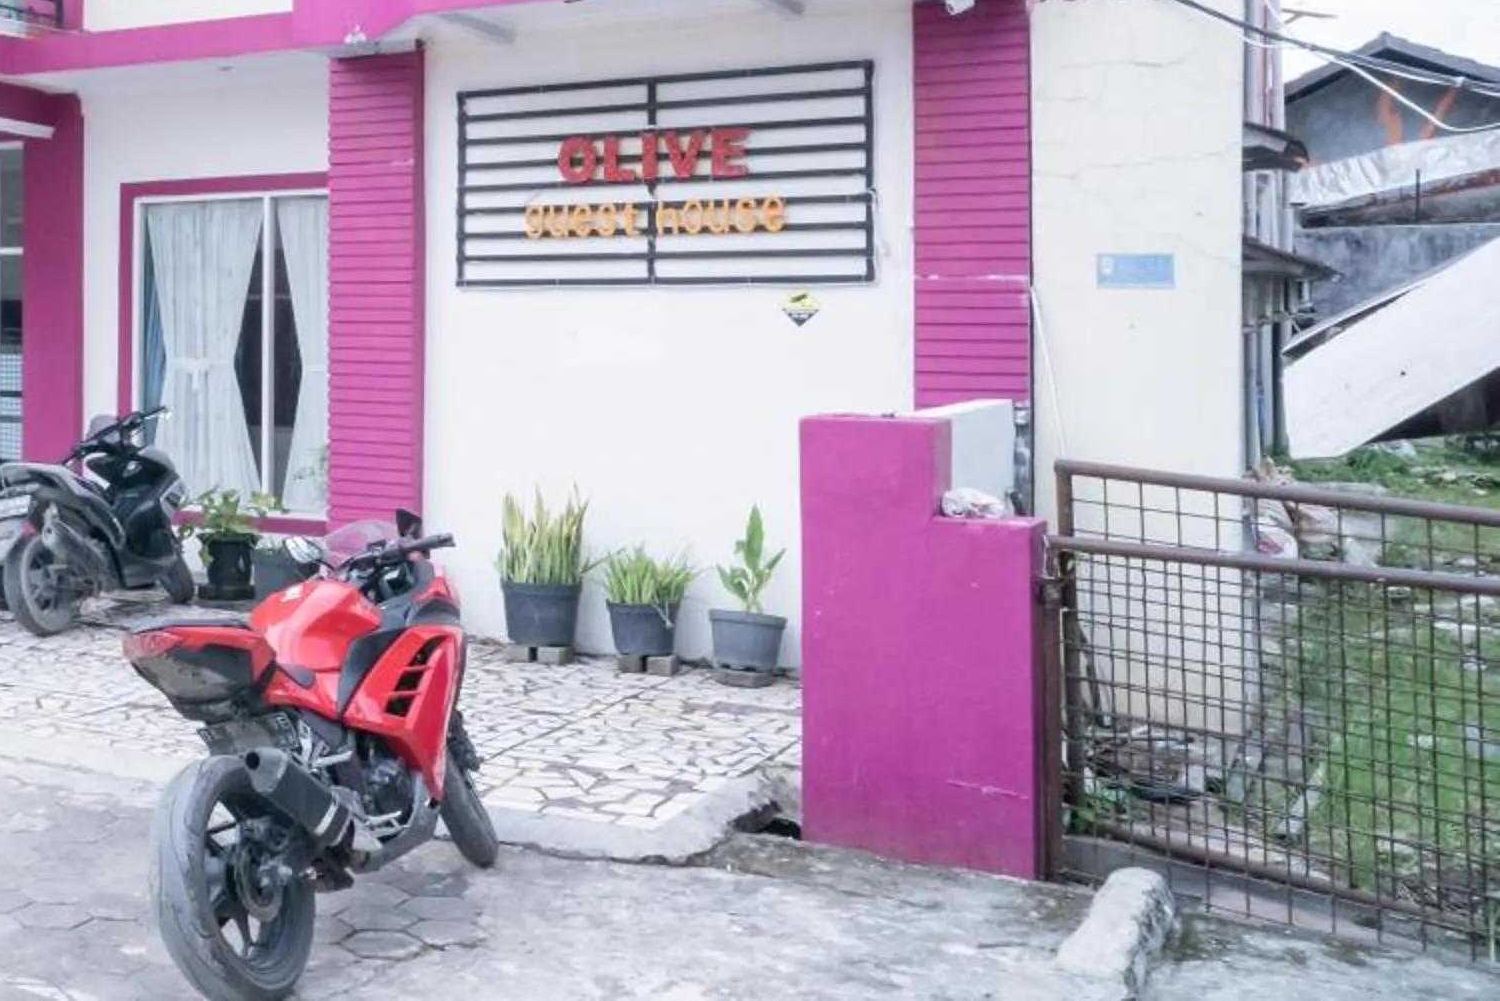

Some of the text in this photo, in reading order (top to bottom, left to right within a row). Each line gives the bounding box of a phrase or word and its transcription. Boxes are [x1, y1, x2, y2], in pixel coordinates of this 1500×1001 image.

[557, 127, 751, 183] OLIVE
[525, 194, 788, 238] guest house
